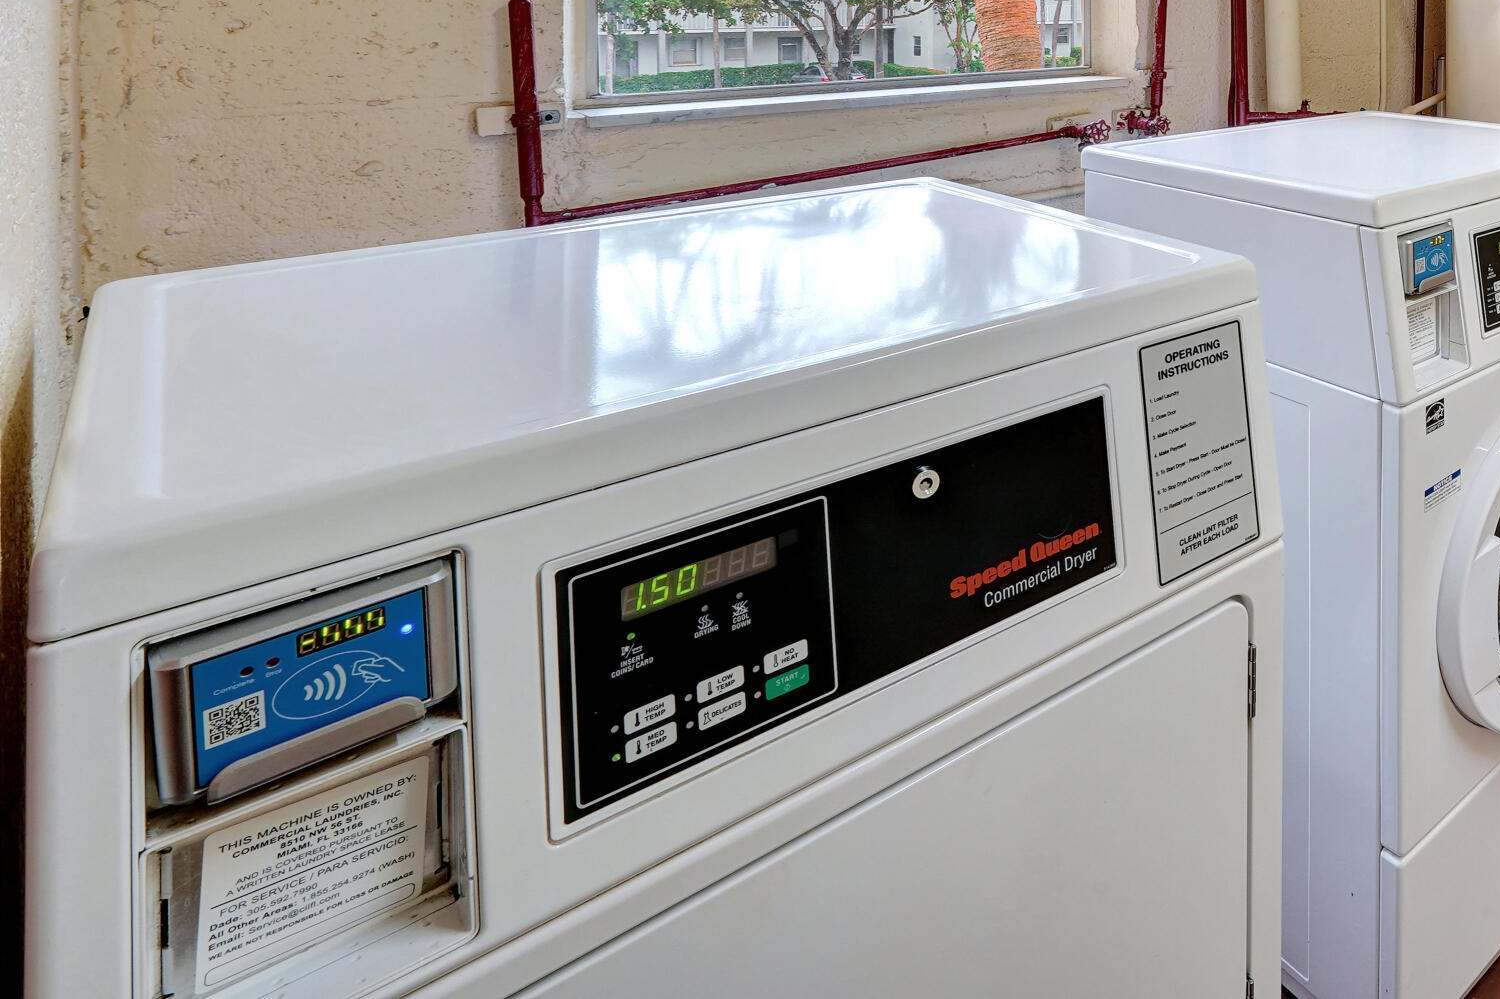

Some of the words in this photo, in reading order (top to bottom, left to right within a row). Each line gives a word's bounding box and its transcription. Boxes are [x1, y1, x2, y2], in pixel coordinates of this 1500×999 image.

[1165, 339, 1220, 363] OPERATING
[1158, 350, 1229, 380] INSTRUCTIONS
[1164, 391, 1179, 399] Laundry
[1169, 427, 1179, 435] Cycle
[1180, 421, 1196, 430] Selection
[1176, 461, 1186, 469] Dryer
[1188, 474, 1200, 483] During
[1434, 474, 1452, 491] NOTICE
[1179, 532, 1201, 547] CLEAN
[1203, 524, 1216, 536] LINT
[1218, 514, 1238, 528] FILTER
[1181, 541, 1202, 556] AFTER
[1203, 533, 1220, 545] EACH
[1222, 523, 1238, 536] LOAD
[950, 548, 1027, 599] Speed
[1030, 522, 1100, 562] Queen
[984, 561, 1060, 608] Commercial
[1065, 547, 1097, 572] Dryer
[636, 563, 697, 611] 1.50
[732, 618, 751, 631] DOWN
[733, 613, 750, 624] COOL
[694, 624, 719, 639] DRYING
[620, 653, 644, 668] INSERT
[781, 652, 799, 664] HEAT
[784, 648, 795, 656] NO
[635, 656, 654, 670] CARD
[213, 678, 255, 696] Complete
[716, 679, 736, 692] TEMP
[717, 672, 734, 684] LOW
[776, 671, 799, 686] START
[645, 702, 665, 714] HIGH
[645, 708, 666, 722] TEMP
[712, 700, 742, 718] DELICATES
[646, 735, 668, 749] TEMP
[647, 729, 665, 742] MED
[218, 837, 252, 854] THIS
[257, 808, 323, 839] MACHINE
[327, 803, 339, 813] IS
[344, 782, 393, 807] OWNED
[397, 774, 417, 787] BY:
[232, 824, 312, 859] COMMERCIAL
[315, 799, 380, 827] LAUNDRIES,
[384, 789, 404, 801] INC.
[280, 834, 305, 849] 8510
[309, 826, 329, 838] NW
[330, 820, 343, 830] 56
[346, 813, 361, 824] ST.
[317, 834, 329, 843] FL
[333, 820, 363, 837] 33166
[235, 872, 259, 886] AND
[262, 867, 273, 875] IS
[275, 845, 327, 870] COVERED
[329, 822, 382, 848] PURSUANT
[385, 817, 398, 825] TO
[236, 869, 286, 893] WRITTEN
[288, 849, 336, 872] LAUNDRY
[340, 835, 372, 852] SPACE
[375, 821, 406, 837] LEASE
[219, 899, 248, 917] FOR
[251, 877, 307, 904] SERVICE
[317, 860, 349, 876] PARA
[352, 835, 409, 863] SERVICIO:
[208, 930, 224, 942] All
[228, 916, 260, 934] Other
[262, 900, 299, 920] Areas:
[302, 869, 376, 903] 1.855.254.9274
[378, 851, 416, 872] (WASH)
[208, 952, 222, 961] WE
[224, 943, 243, 955] ARE
[246, 934, 264, 945] NOT
[266, 911, 324, 937] RESPONSIBLE
[326, 901, 343, 912] FOR
[345, 892, 366, 903] LOSS
[368, 885, 380, 893] OR
[382, 871, 414, 888] DAMAGE
[209, 914, 244, 933] Dade:
[247, 882, 318, 916] 305.592.7990
[208, 932, 245, 952] Email:
